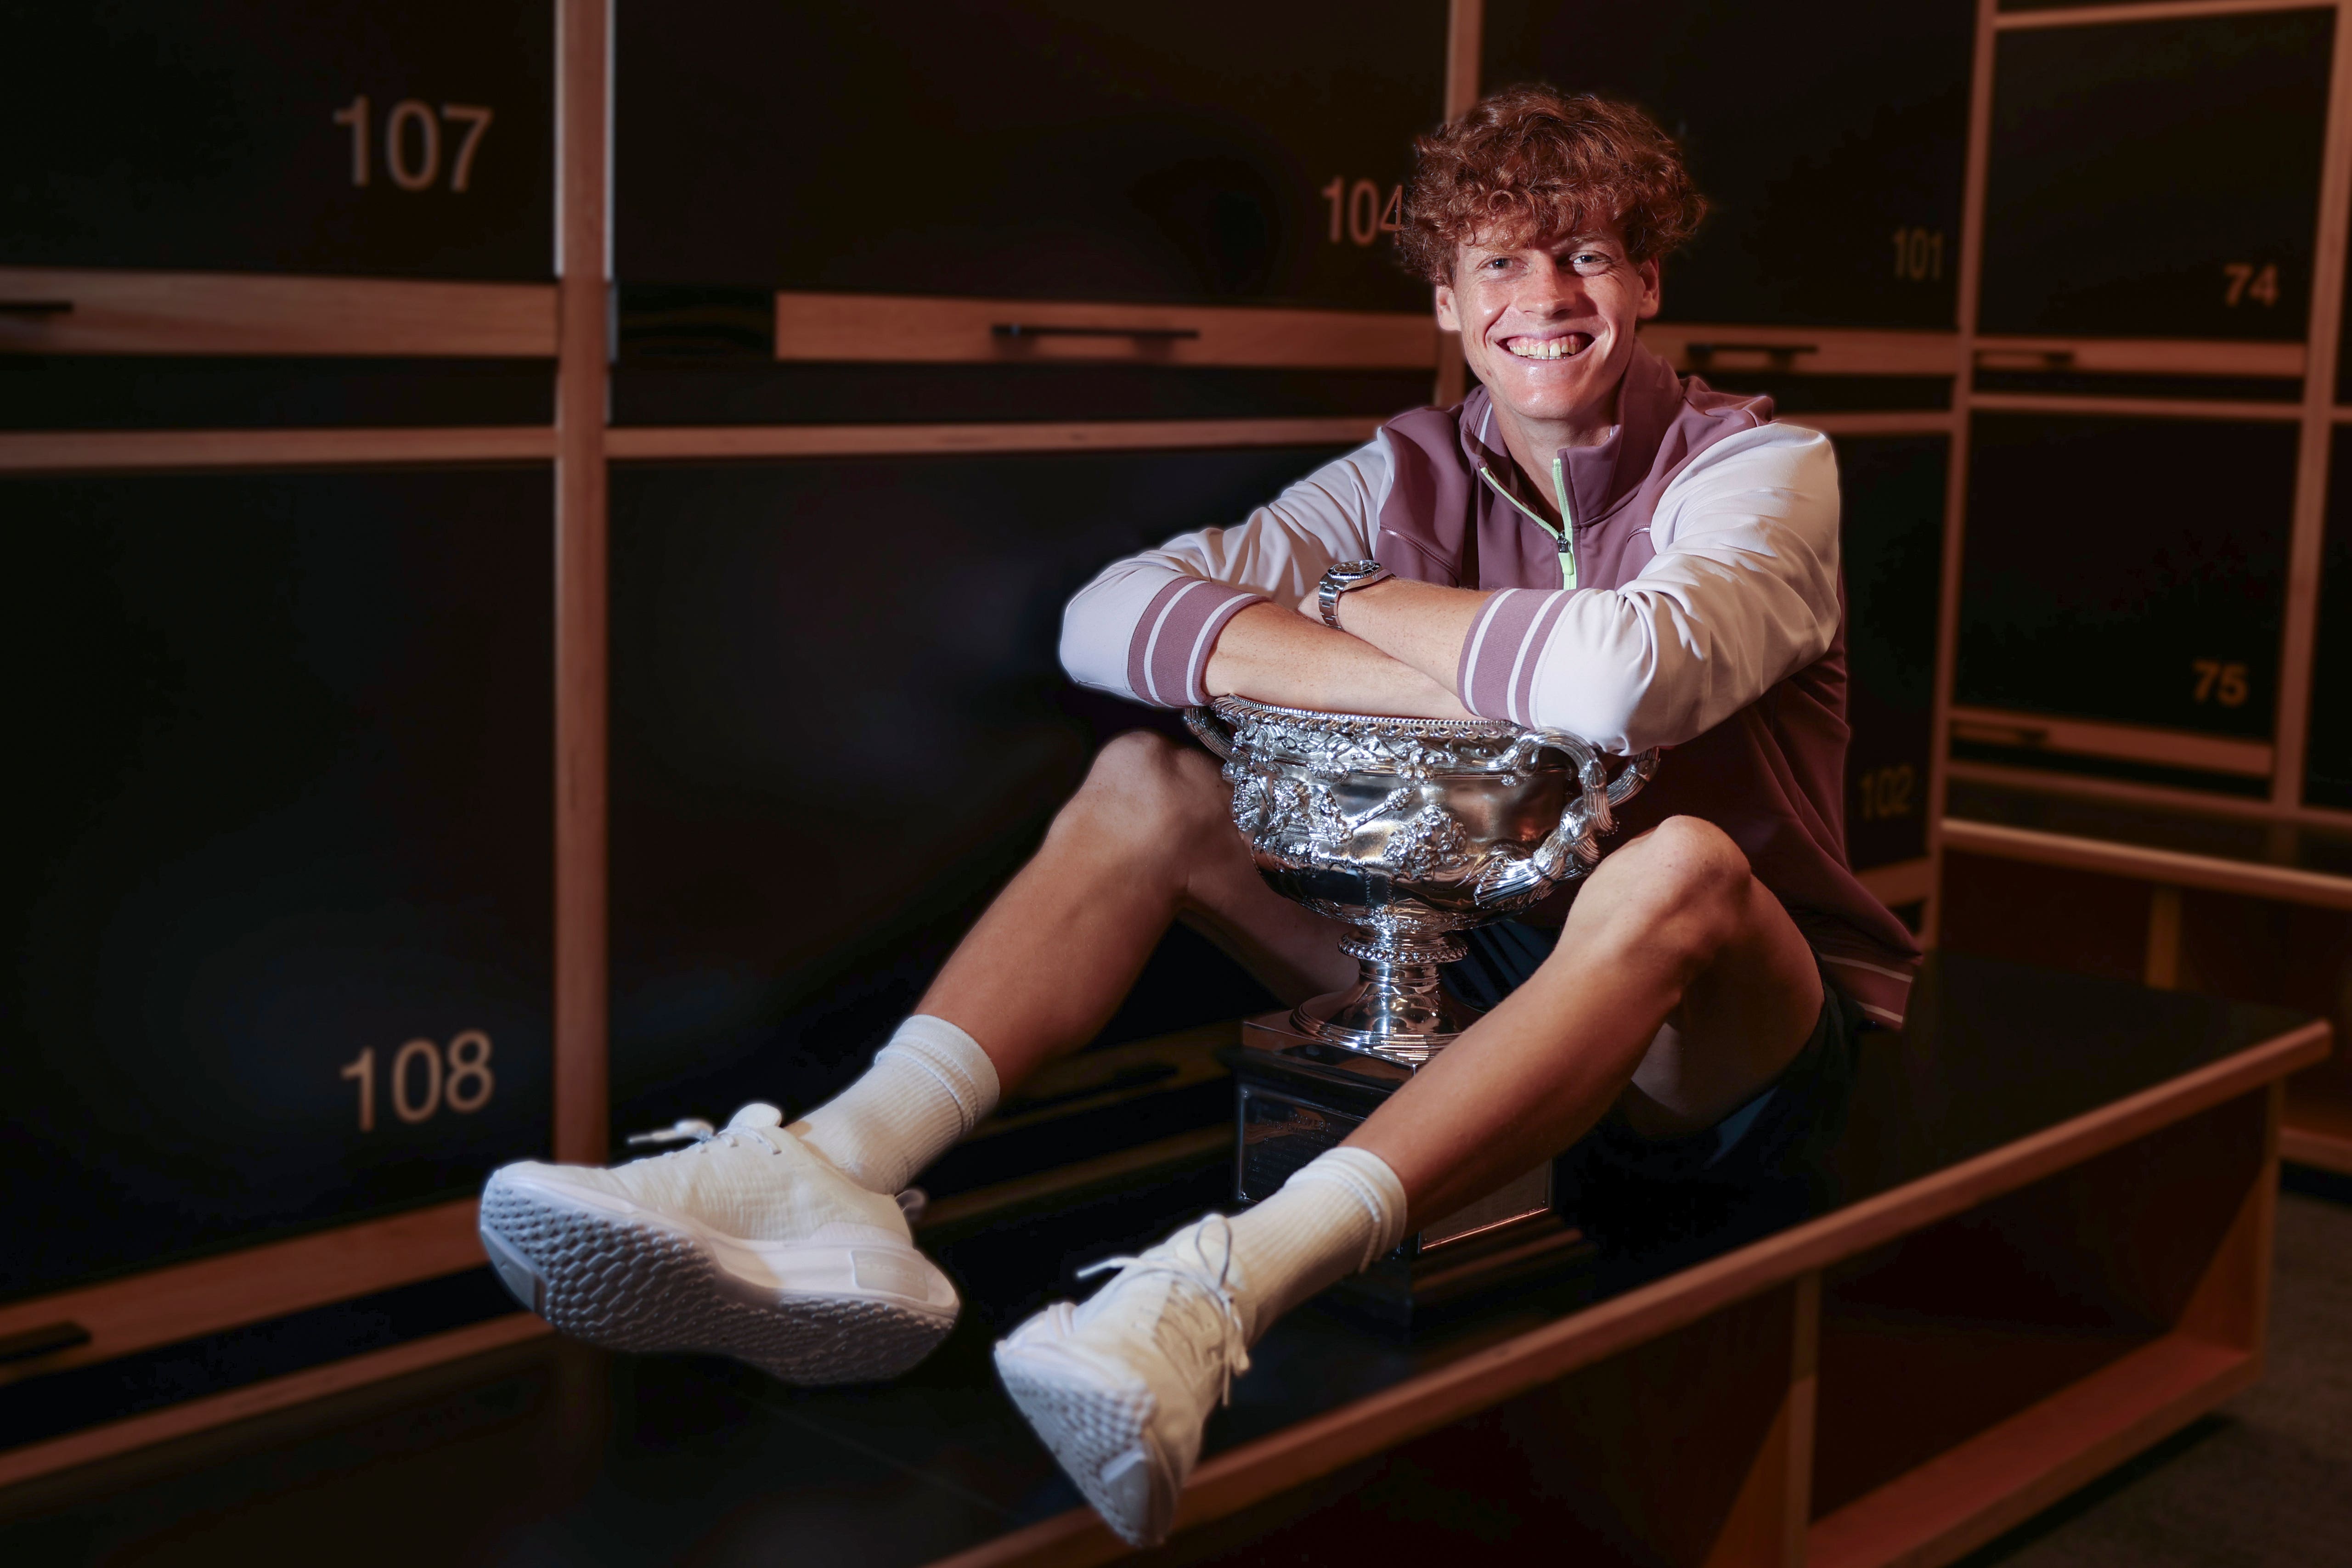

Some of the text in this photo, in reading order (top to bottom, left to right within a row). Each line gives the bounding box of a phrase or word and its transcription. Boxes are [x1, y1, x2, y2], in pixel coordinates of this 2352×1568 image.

[334, 96, 492, 192] 107
[1322, 175, 1404, 245] 104
[1892, 227, 1944, 282] 101
[2225, 264, 2279, 305] 74
[2194, 660, 2248, 707] 75
[1860, 763, 1913, 819] 102
[341, 1030, 493, 1130] 108
